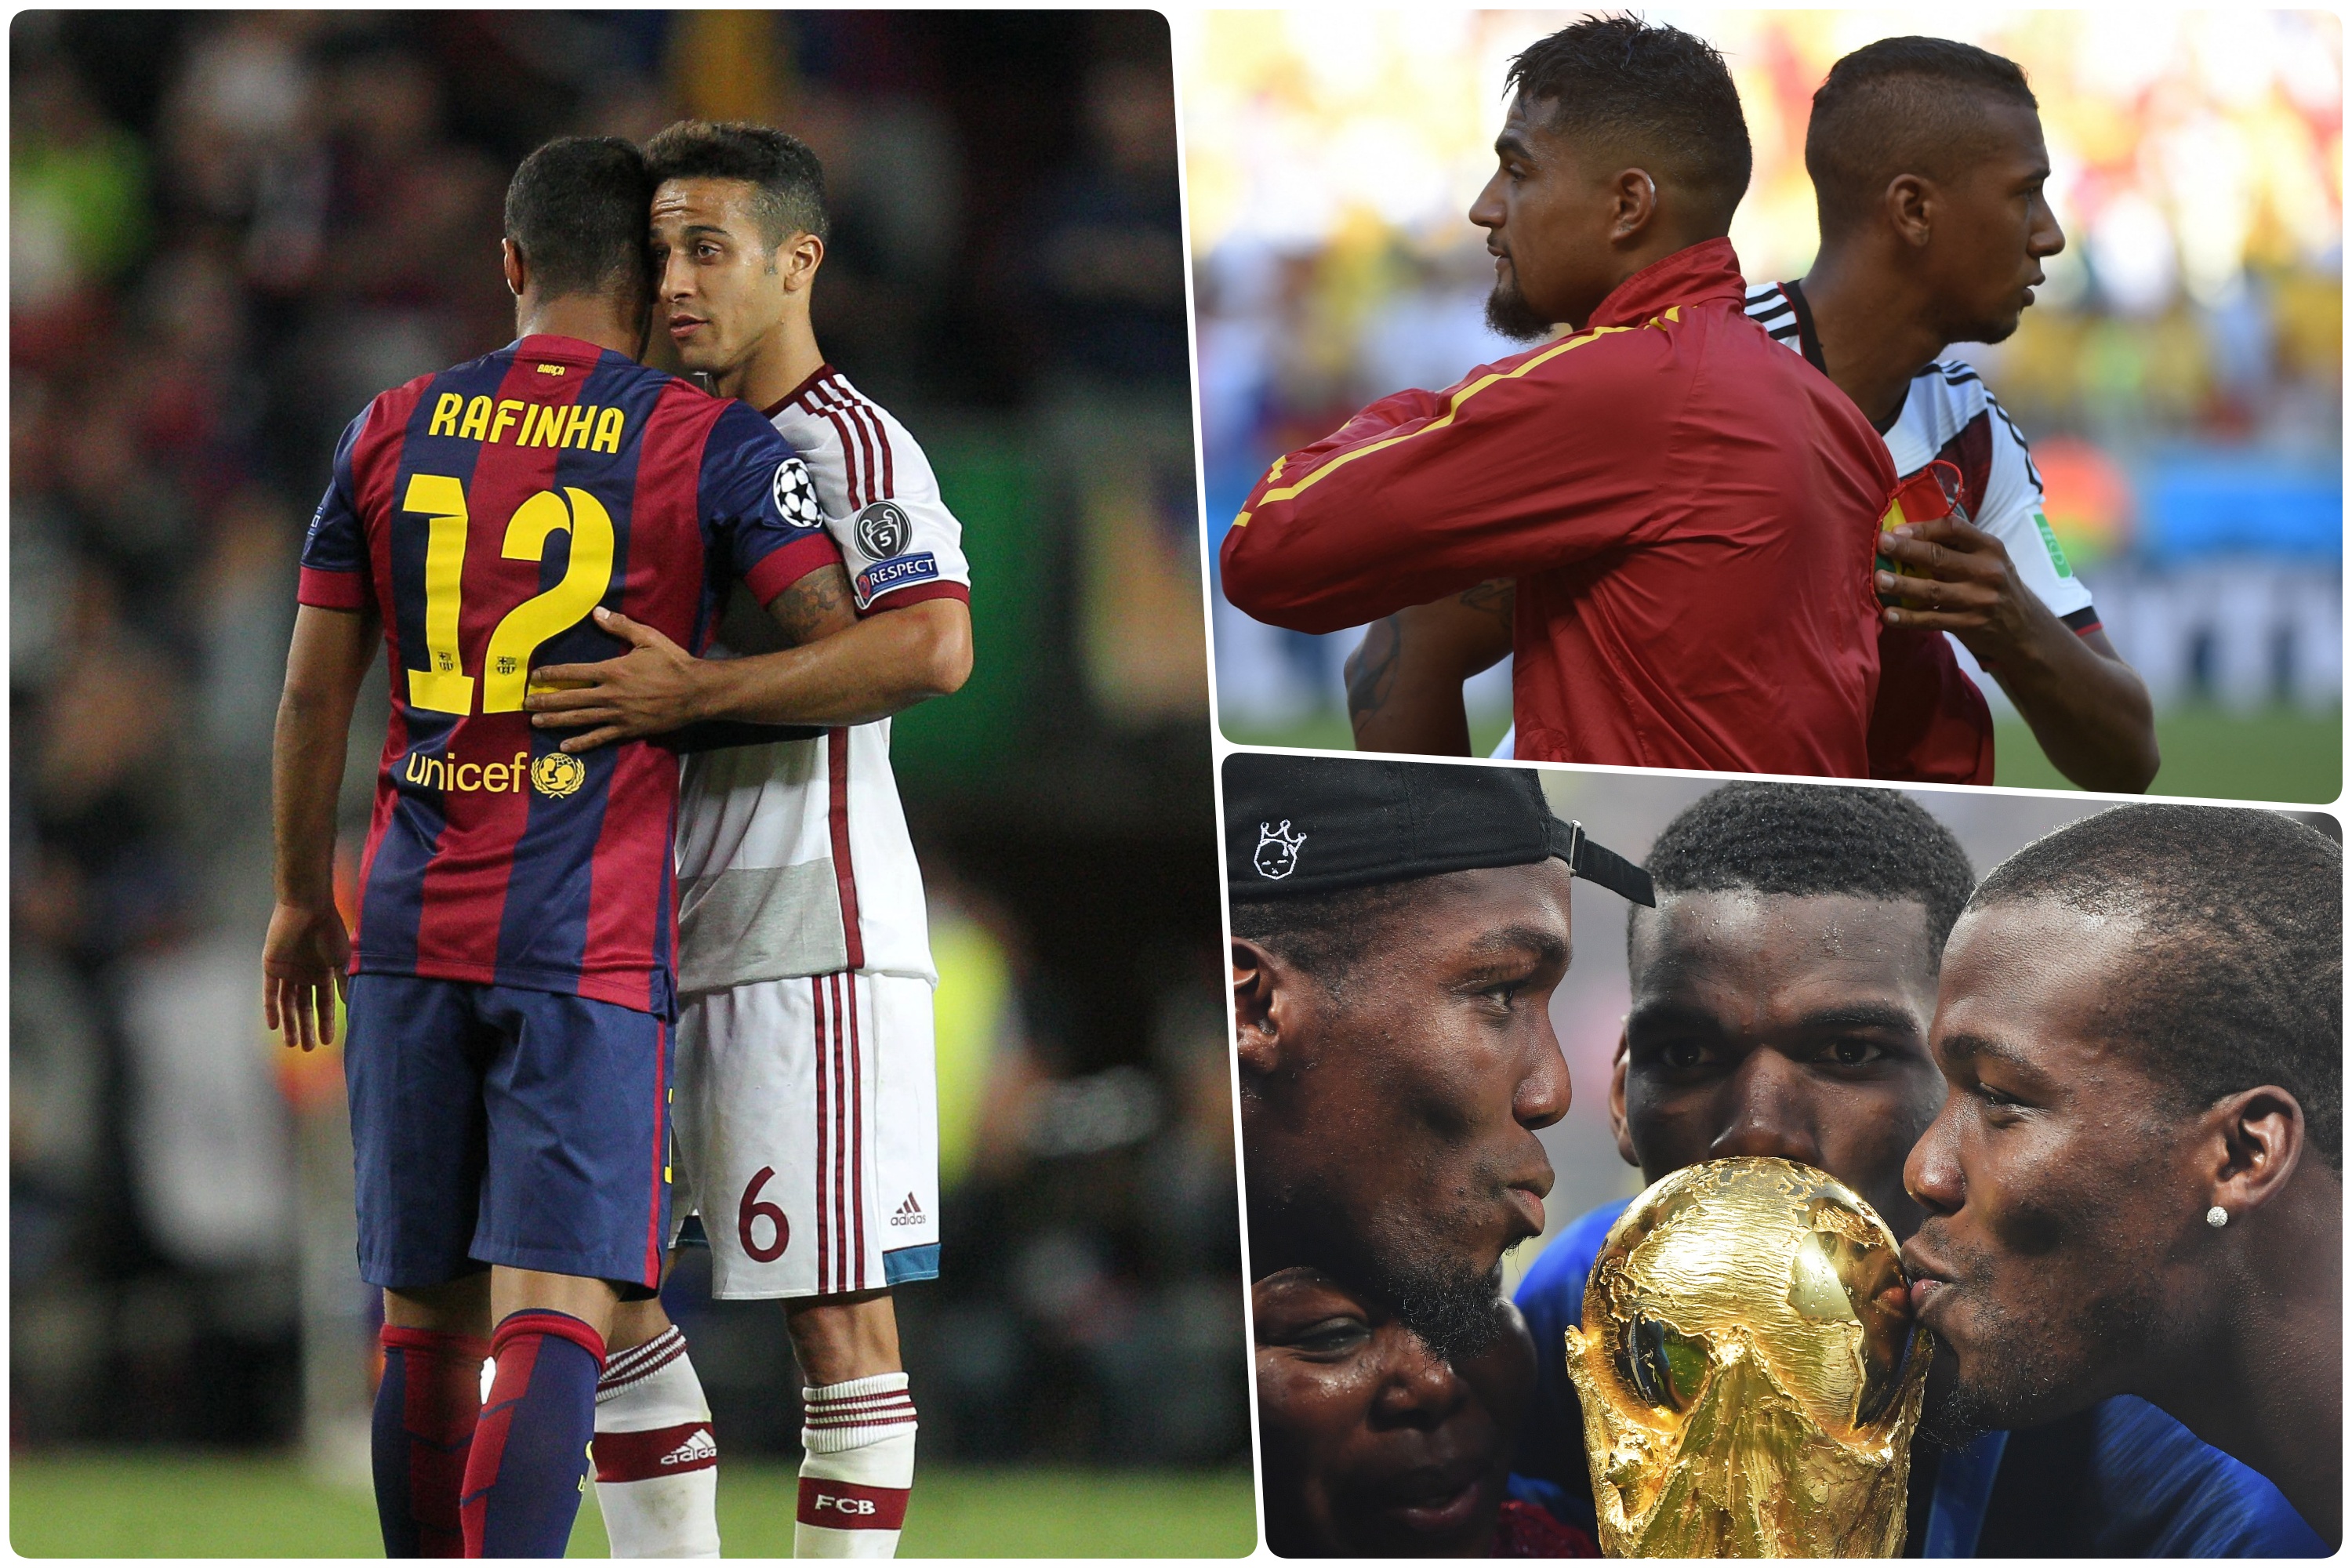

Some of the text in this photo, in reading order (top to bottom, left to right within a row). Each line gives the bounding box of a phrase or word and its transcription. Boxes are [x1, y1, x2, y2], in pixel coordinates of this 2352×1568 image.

[428, 393, 625, 454] RAFINHA
[879, 531, 892, 547] 5
[869, 559, 934, 586] RESPECT
[402, 474, 615, 716] 12
[405, 751, 528, 793] unicef
[739, 1166, 790, 1263] 6
[891, 1212, 927, 1226] adidas
[660, 1446, 717, 1465] adida
[815, 1494, 876, 1515] FCB
